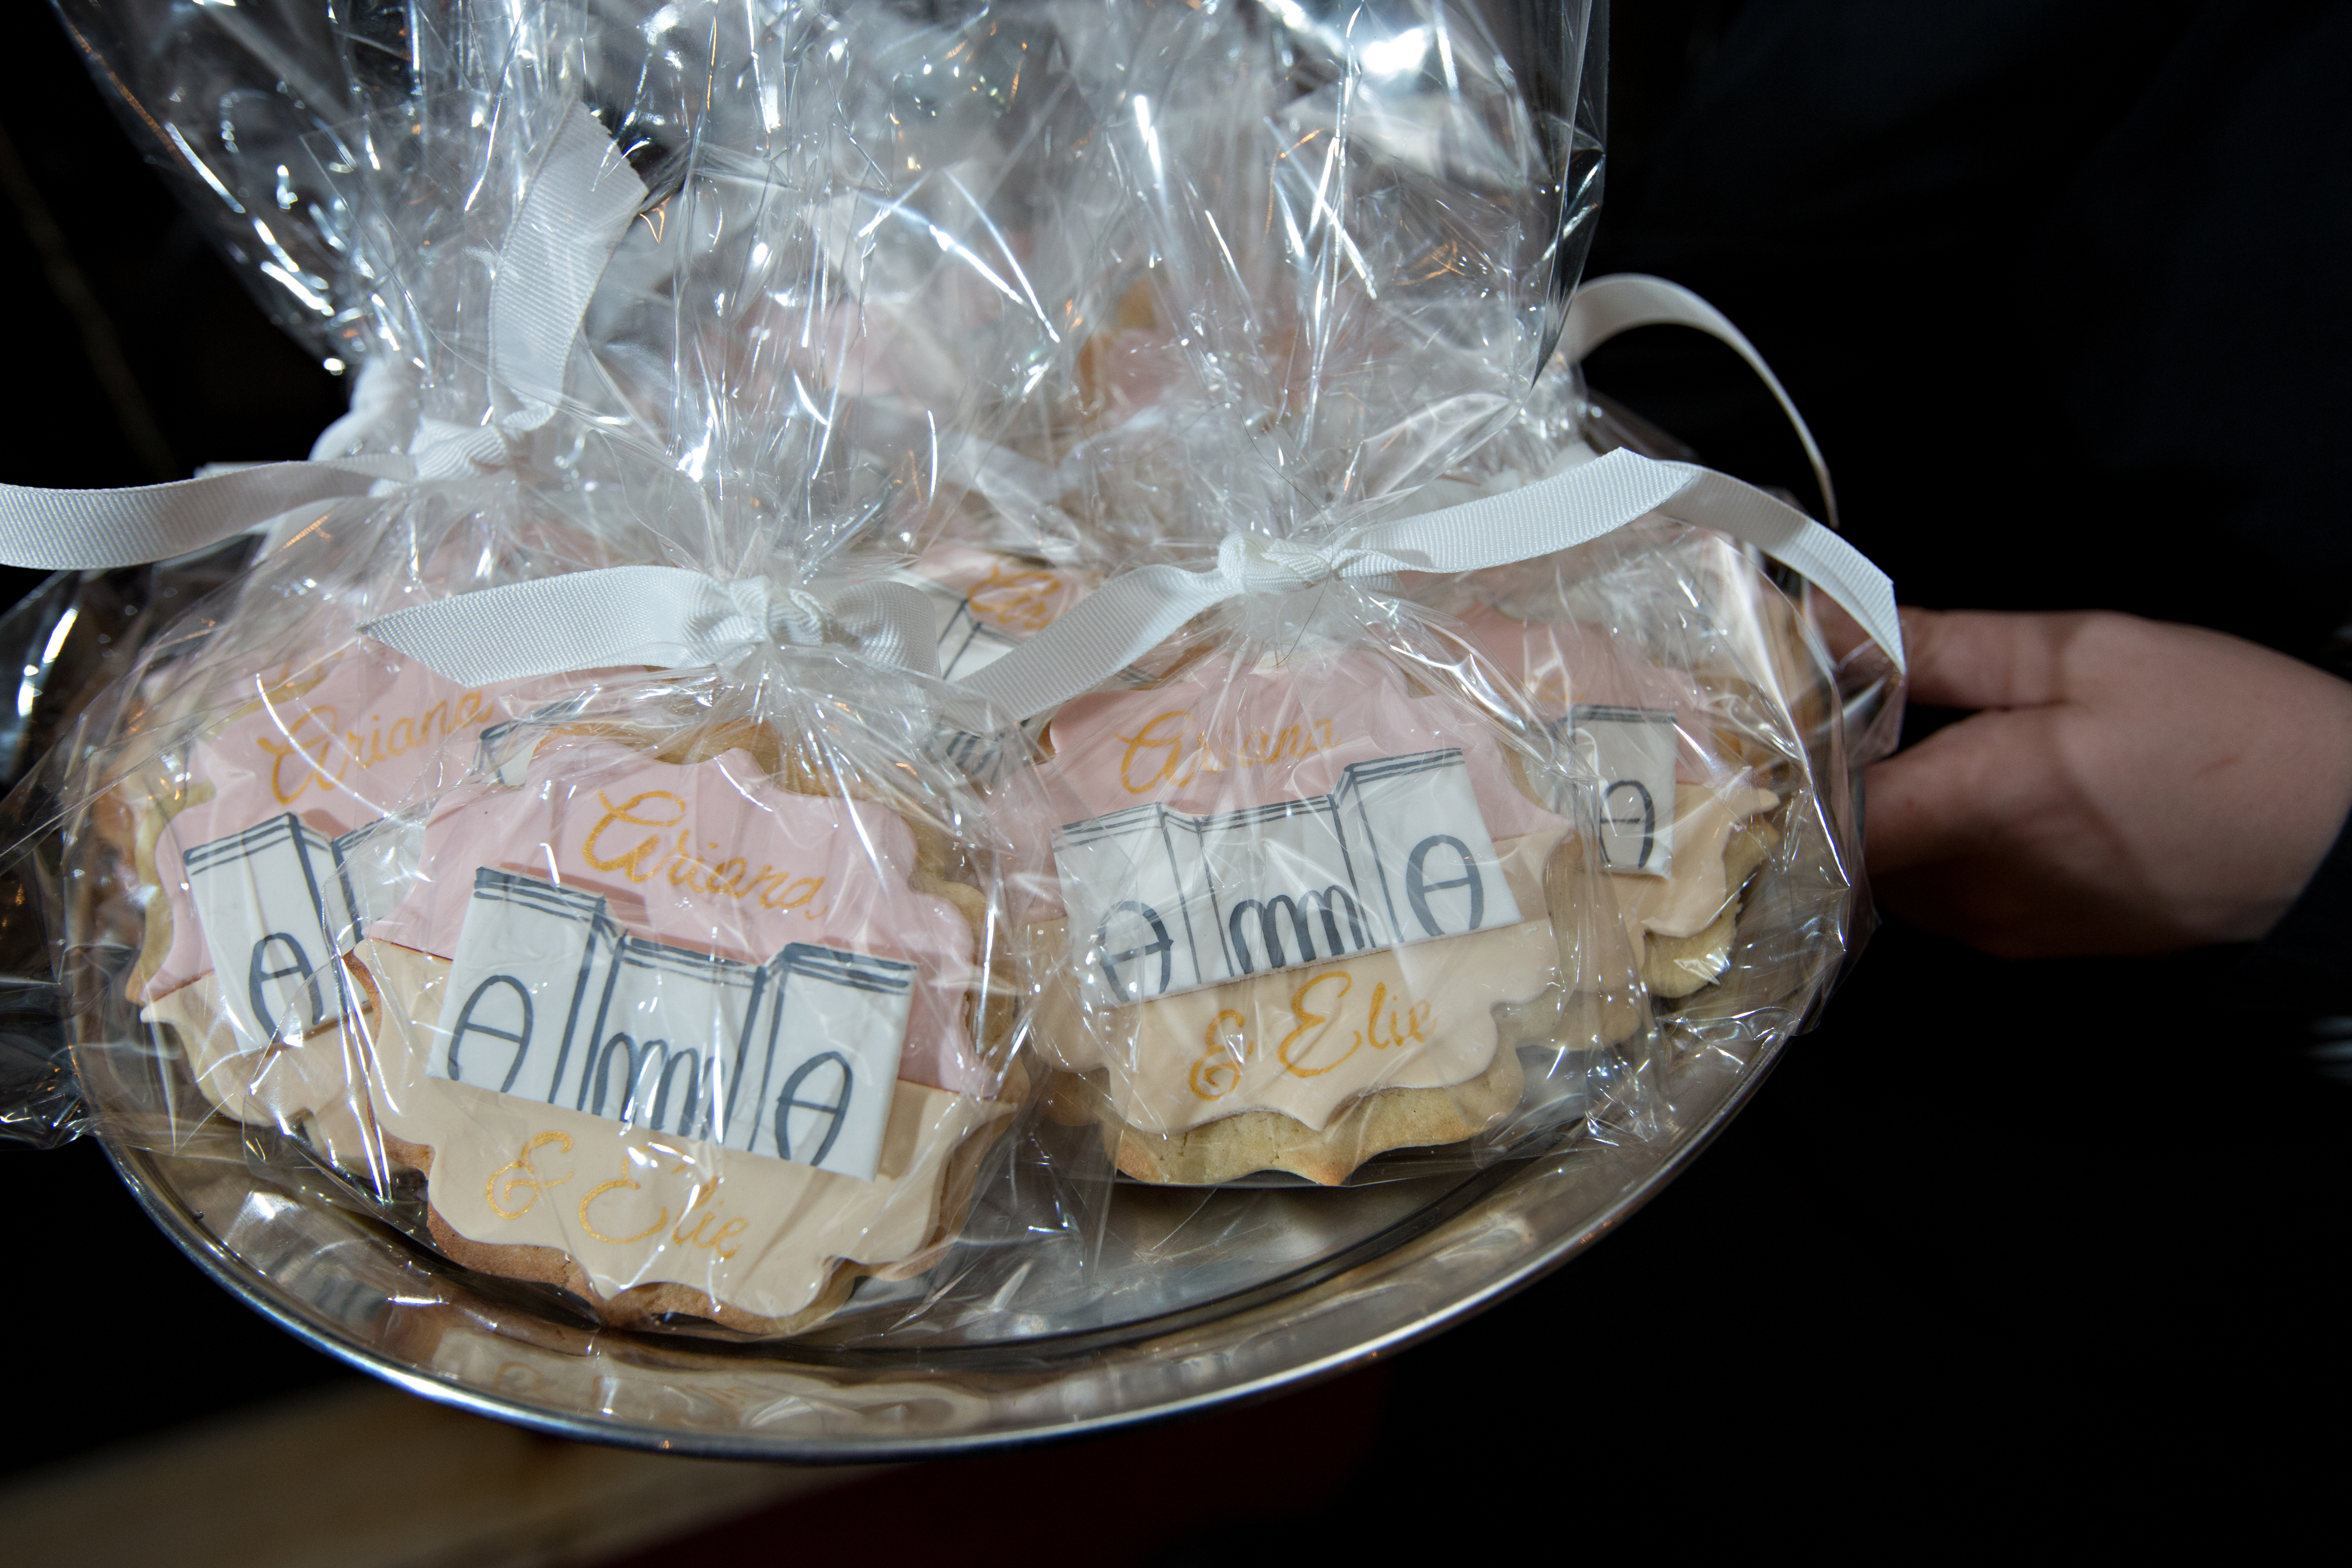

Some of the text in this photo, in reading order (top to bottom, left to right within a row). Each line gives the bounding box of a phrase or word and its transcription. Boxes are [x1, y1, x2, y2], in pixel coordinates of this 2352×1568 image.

[582, 790, 829, 921] Ariana
[1189, 971, 1438, 1101] & Elie
[486, 1131, 750, 1259] & Elie
